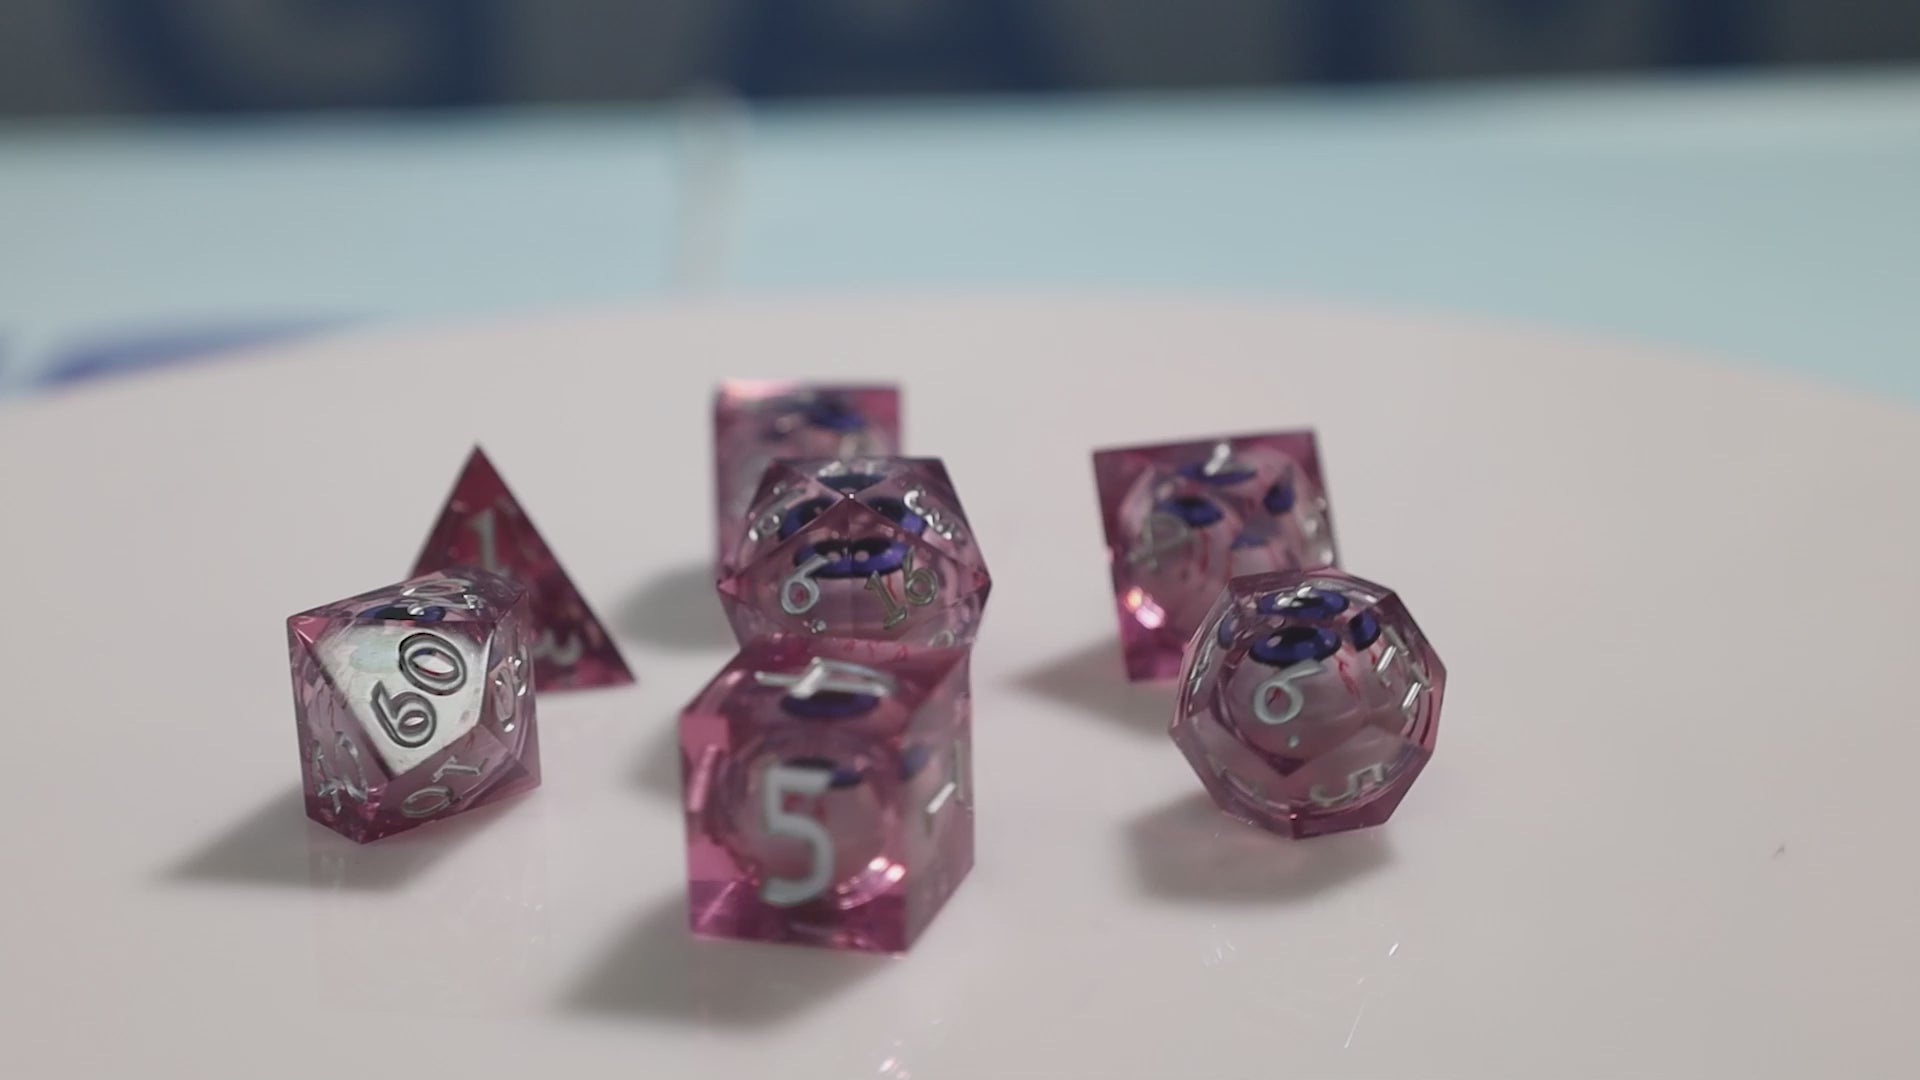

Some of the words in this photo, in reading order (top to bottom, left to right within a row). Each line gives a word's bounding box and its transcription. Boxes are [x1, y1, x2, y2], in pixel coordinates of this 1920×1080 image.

[864, 546, 938, 630] 16
[371, 632, 468, 749] 60
[757, 764, 835, 906] 5
